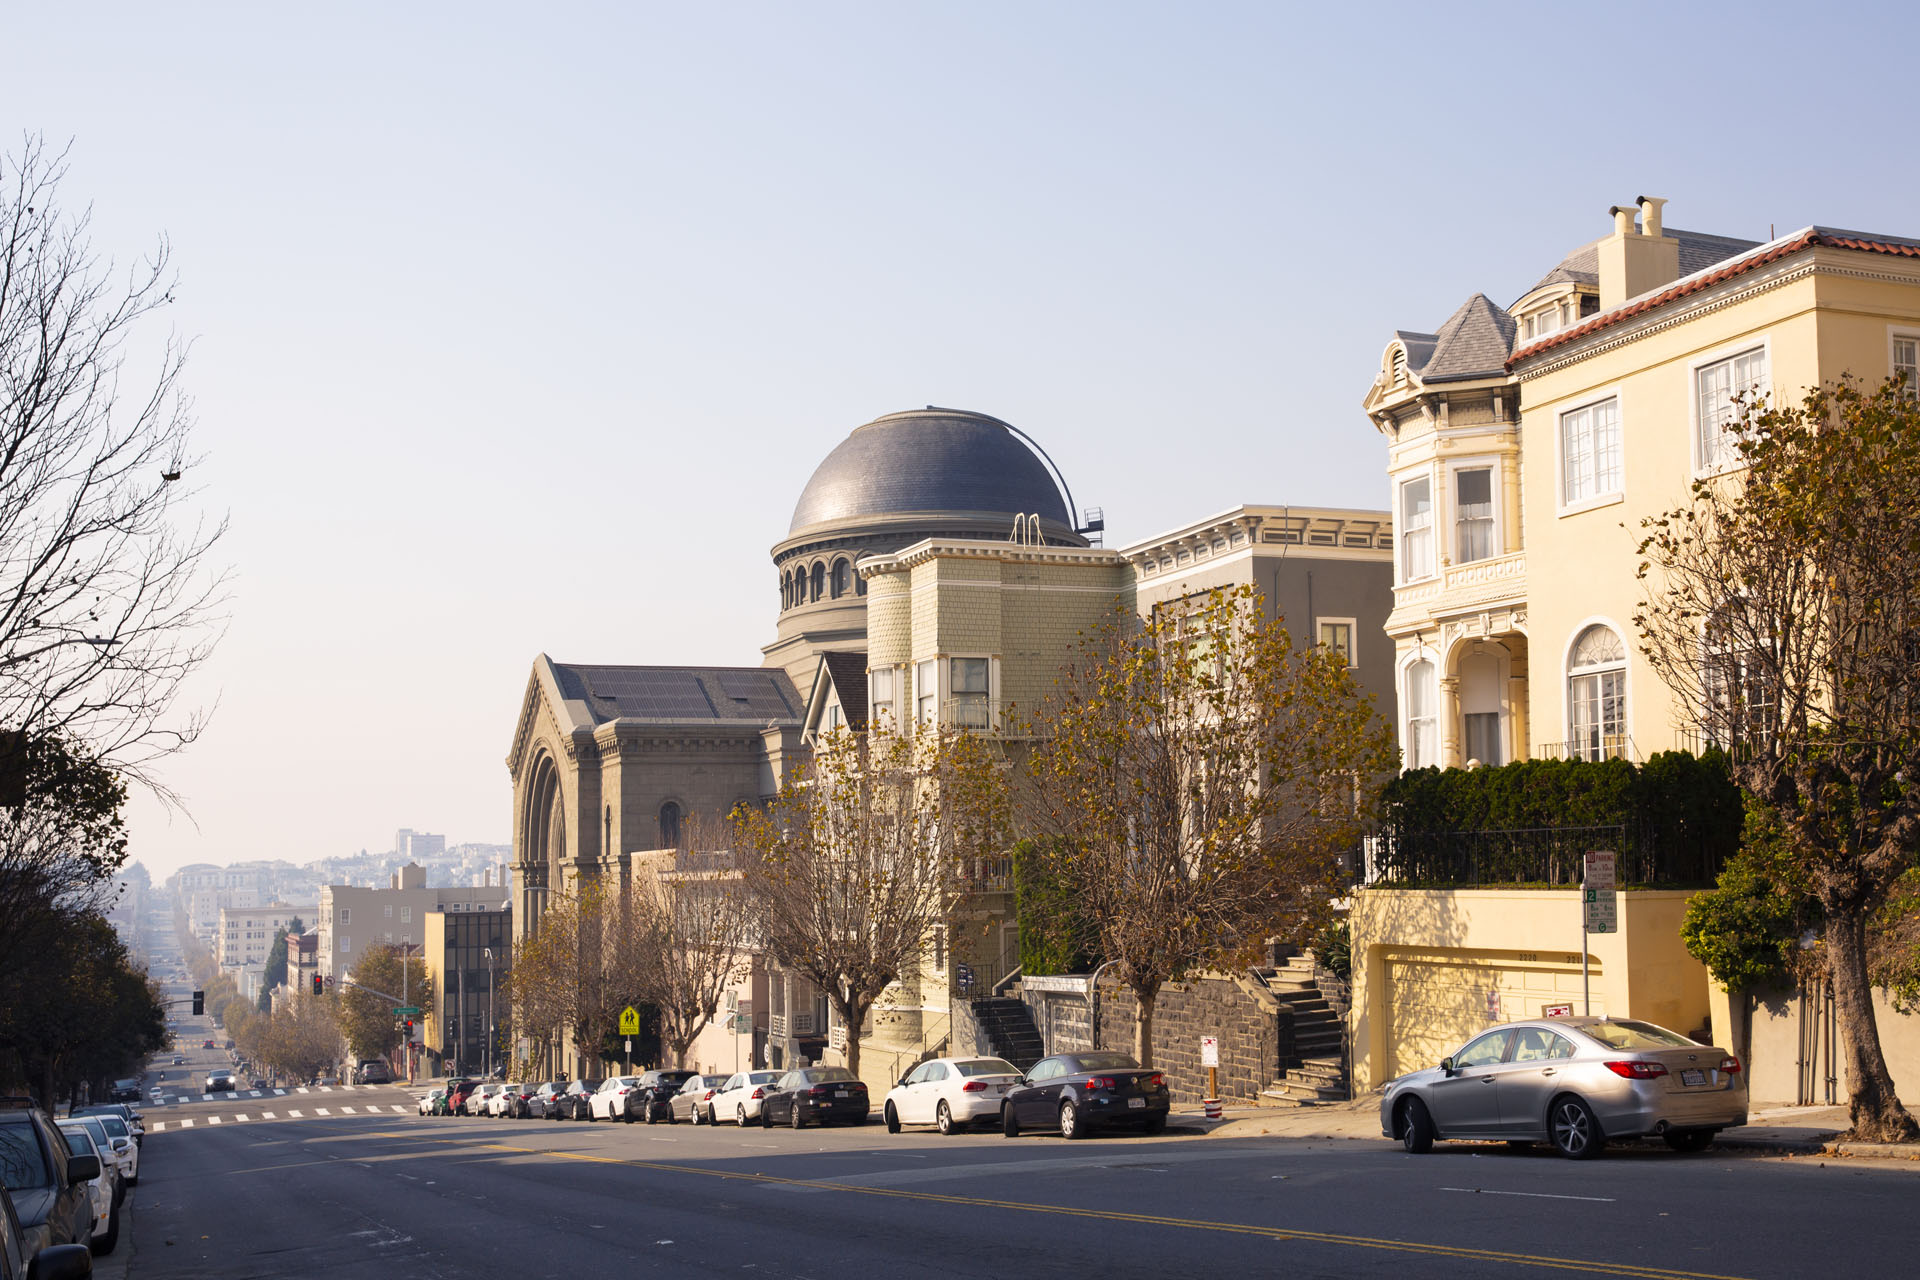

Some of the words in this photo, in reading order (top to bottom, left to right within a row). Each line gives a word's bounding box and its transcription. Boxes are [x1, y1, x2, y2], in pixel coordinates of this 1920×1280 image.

[1587, 853, 1595, 862] NO
[1588, 891, 1595, 901] 2
[1519, 953, 1537, 962] 2220
